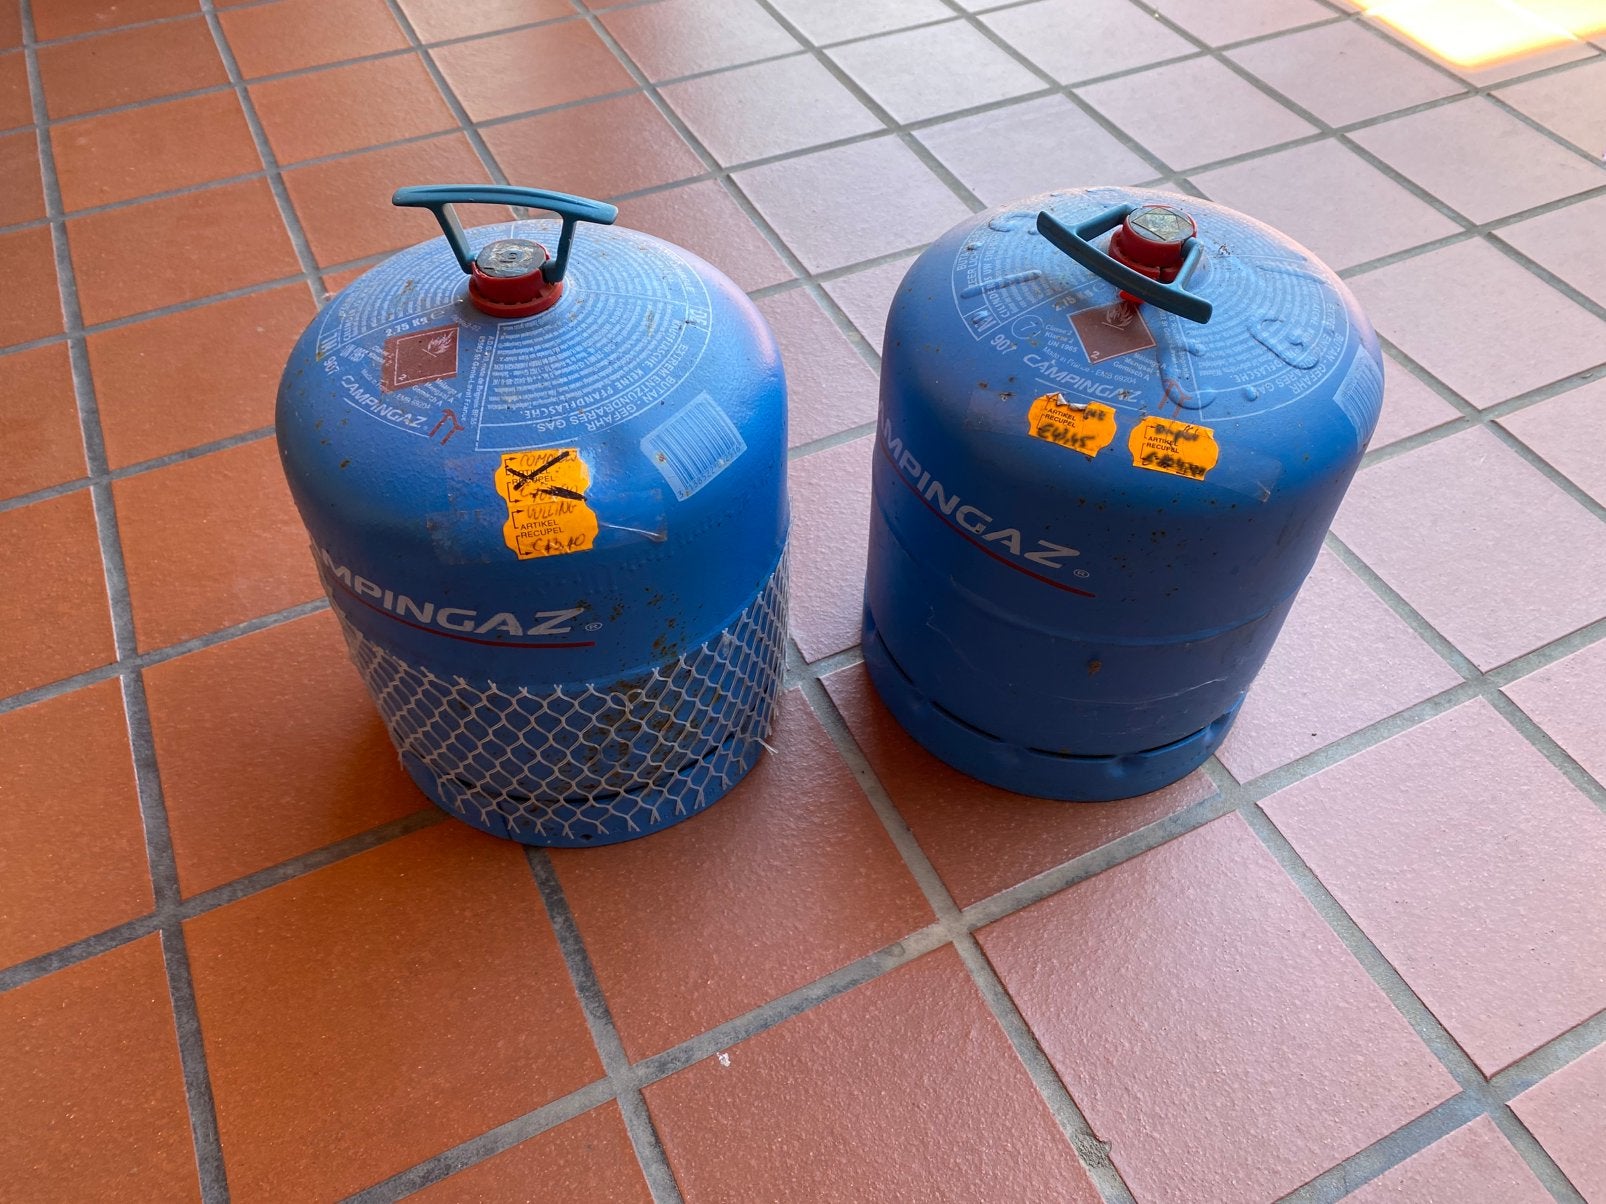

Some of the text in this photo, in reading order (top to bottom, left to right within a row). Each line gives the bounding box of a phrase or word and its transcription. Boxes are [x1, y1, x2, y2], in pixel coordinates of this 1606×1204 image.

[385, 321, 410, 337] 2.75
[1089, 350, 1100, 360] 2
[1328, 333, 1345, 364] BUTAN
[323, 356, 340, 375] 907
[1023, 354, 1143, 402] CAMPINGAZ
[1289, 364, 1327, 395] GEFAHR
[642, 376, 677, 404] BUTAN
[341, 375, 428, 428] CAMPINGAZ
[586, 404, 637, 432] GEFAHR
[1045, 414, 1076, 428] RECUPEL
[1048, 408, 1077, 421] ARTIKEL
[1147, 442, 1179, 453] RECUPEL
[1148, 436, 1178, 446] ARTIKEL
[881, 417, 1080, 568] MPINGAZ
[520, 519, 559, 531] ARTIKEL
[520, 527, 565, 539] RECUPEL
